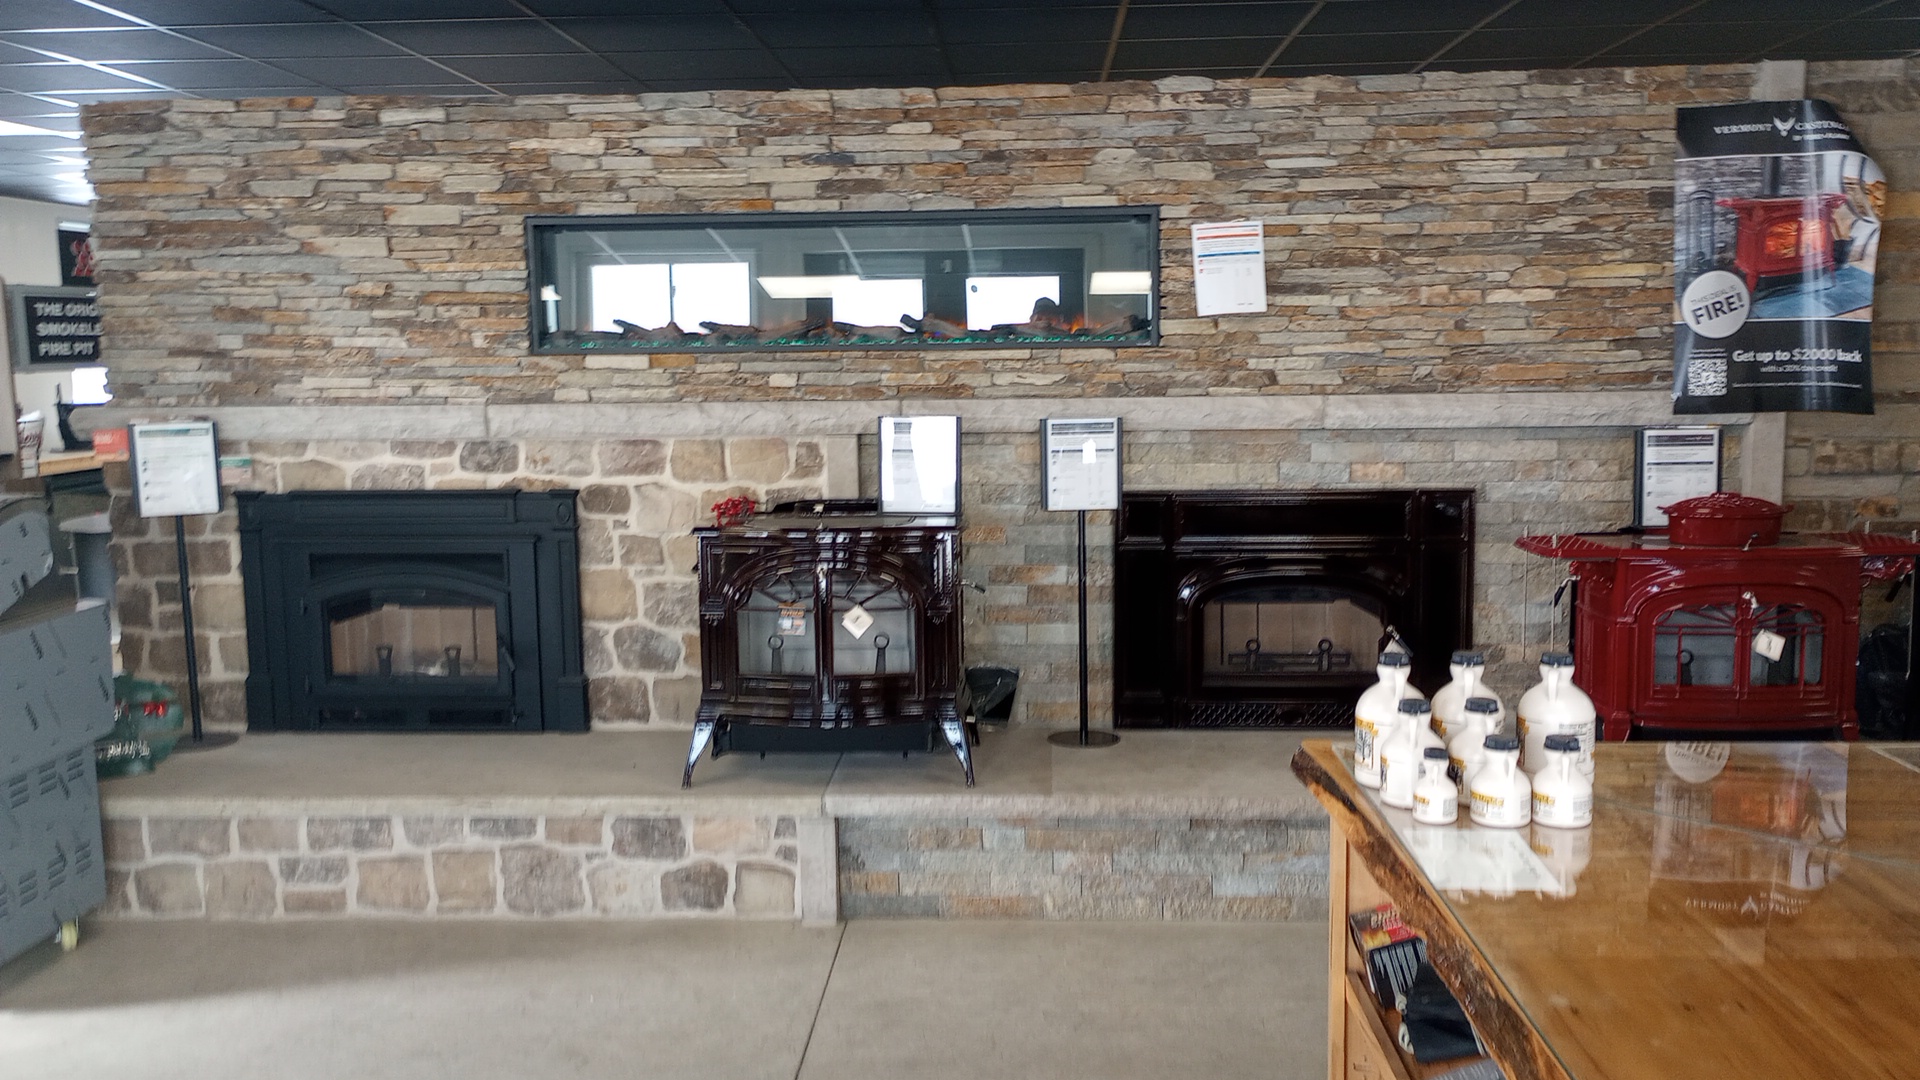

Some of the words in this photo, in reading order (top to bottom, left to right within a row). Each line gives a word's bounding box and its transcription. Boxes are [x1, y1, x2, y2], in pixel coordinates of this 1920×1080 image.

[1713, 123, 1772, 134] VERMONT
[33, 302, 64, 317] THE
[1691, 291, 1745, 325] FIRE!
[38, 341, 73, 356] FIRE
[73, 341, 95, 356] PIT
[1732, 350, 1755, 362] Get
[1755, 352, 1774, 363] up
[1775, 350, 1791, 361] to
[1792, 348, 1836, 361] $2000
[1837, 348, 1862, 363] back
